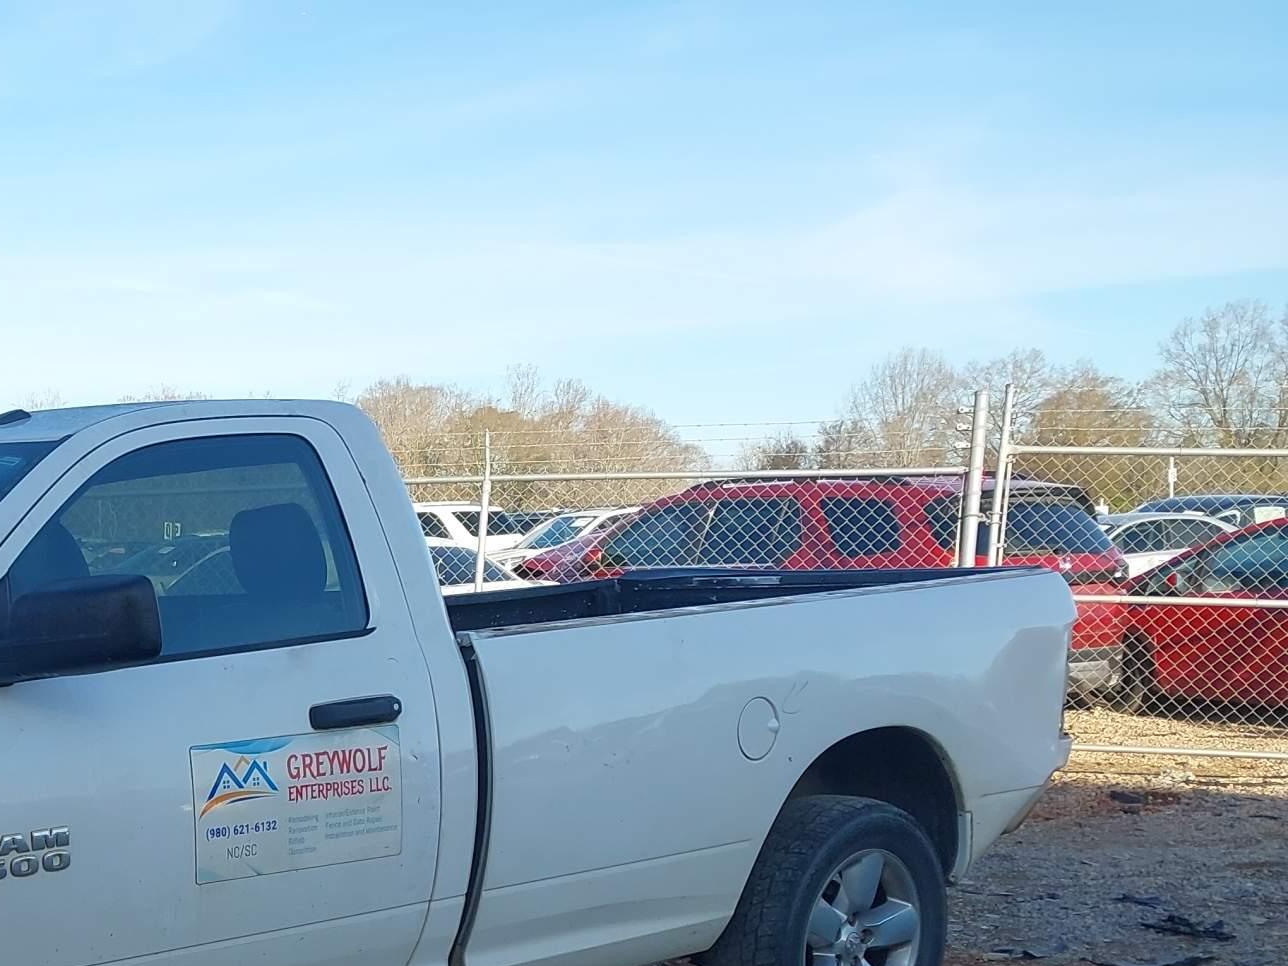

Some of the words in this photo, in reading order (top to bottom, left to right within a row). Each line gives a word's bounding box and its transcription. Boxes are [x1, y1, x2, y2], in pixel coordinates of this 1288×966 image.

[286, 746, 388, 781] GREYWOLF
[288, 779, 365, 803] ENTERPRISES
[206, 826, 231, 842] (980)
[233, 820, 278, 836] 621-6132
[226, 843, 257, 860] NC/SC
